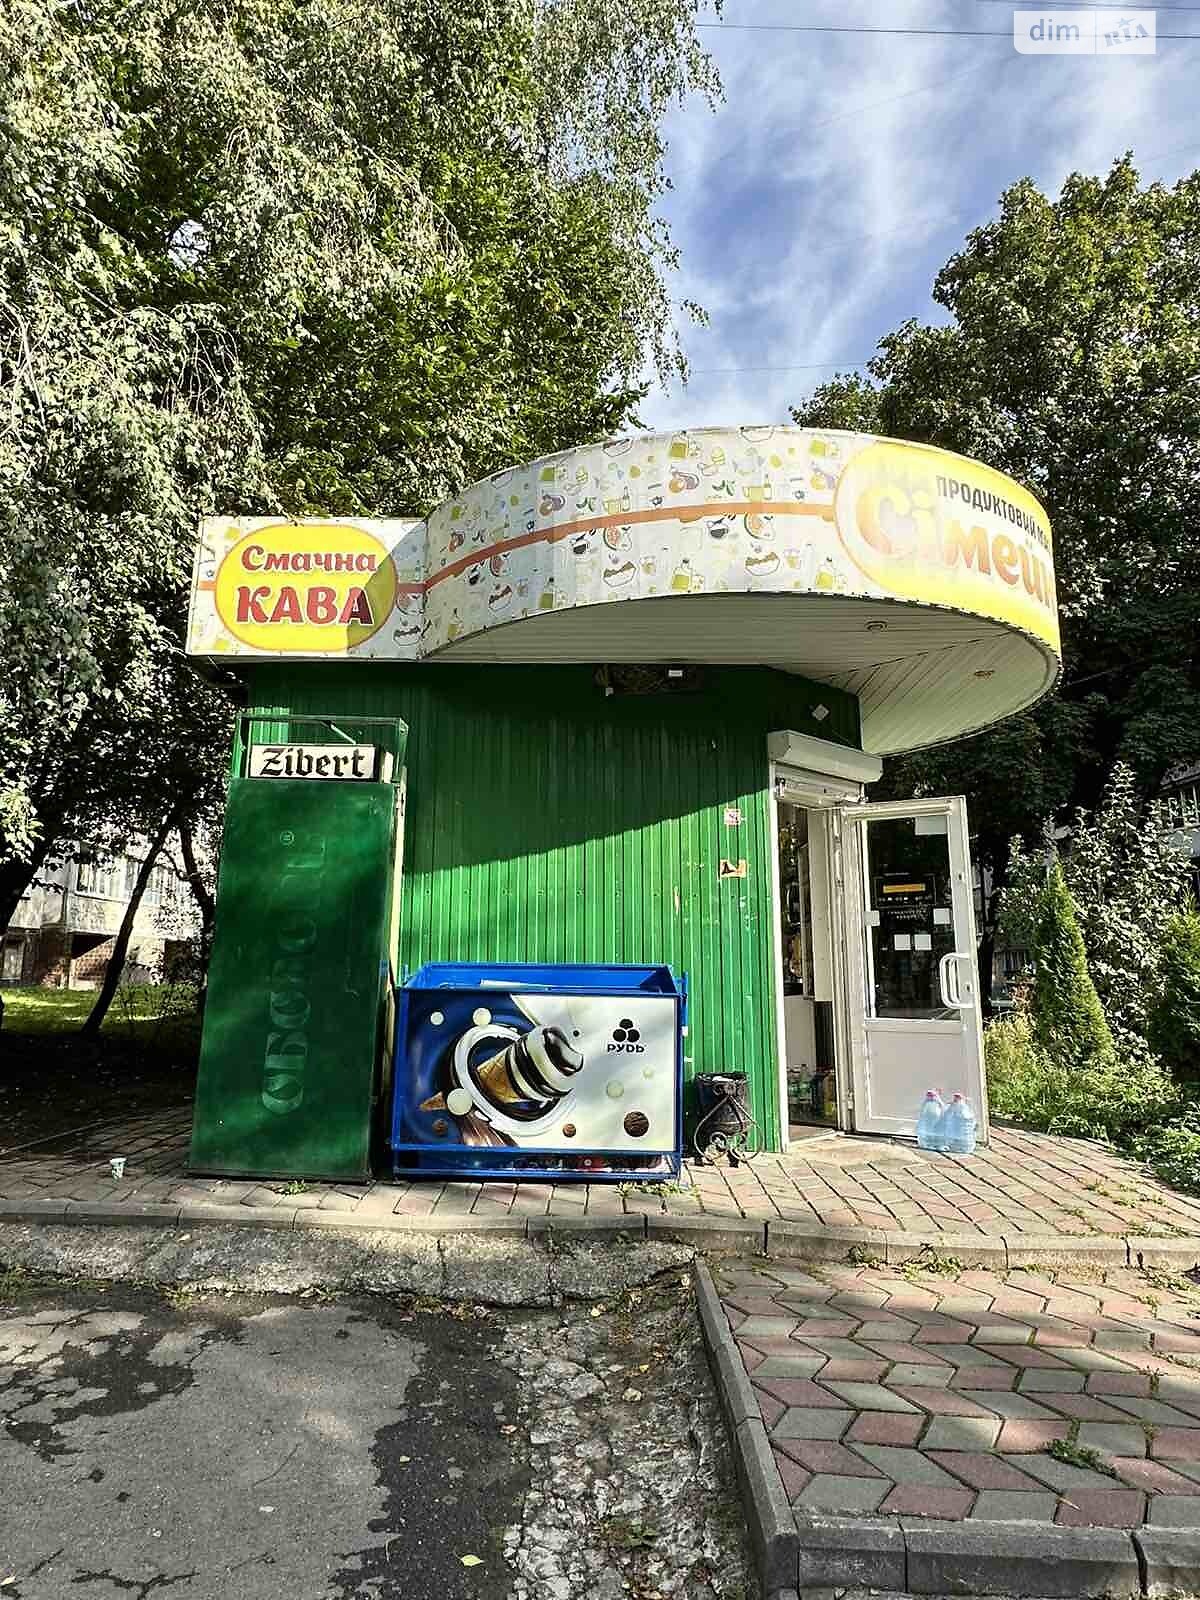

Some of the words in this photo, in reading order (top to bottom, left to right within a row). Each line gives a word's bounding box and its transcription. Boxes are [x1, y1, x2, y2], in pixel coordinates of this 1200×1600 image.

[936, 475, 1037, 540] ПРОДУКТОВИЙ
[241, 545, 376, 572] Смачна
[237, 586, 373, 624] КАВА
[260, 747, 367, 777] Zibert
